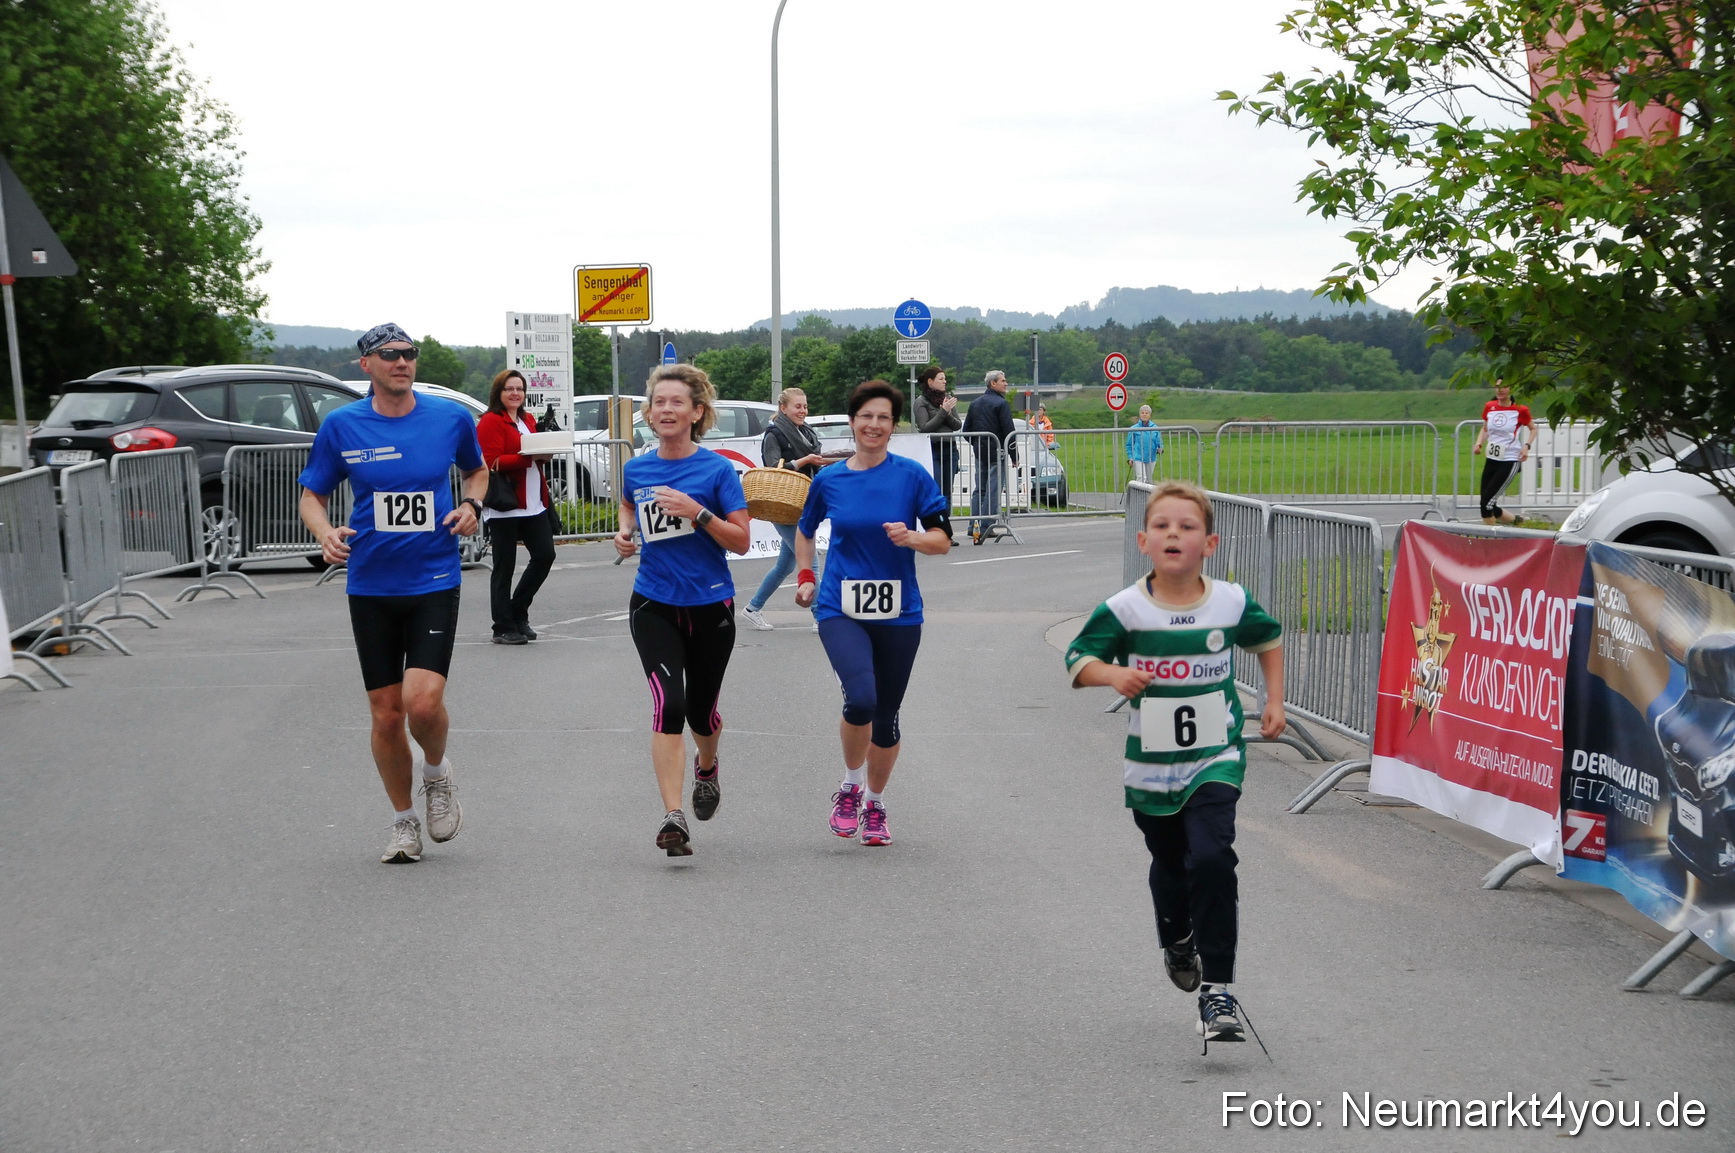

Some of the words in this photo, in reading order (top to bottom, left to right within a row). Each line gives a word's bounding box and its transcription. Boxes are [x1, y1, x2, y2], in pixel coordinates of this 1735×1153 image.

[584, 275, 642, 292] Sengenthal
[609, 292, 635, 302] Anger
[599, 307, 625, 315] Neumarkt
[1109, 360, 1123, 374] 60
[1488, 443, 1501, 457] 36
[383, 494, 427, 526] 126
[643, 501, 683, 535] 124
[755, 540, 771, 552] Tel.
[851, 582, 894, 614] 128
[1169, 615, 1196, 625] JAKO
[1192, 660, 1229, 679] Direkt
[1173, 704, 1198, 748] 6
[1454, 739, 1471, 762] AUF
[1619, 764, 1638, 791] KIA
[1563, 814, 1597, 851] 7
